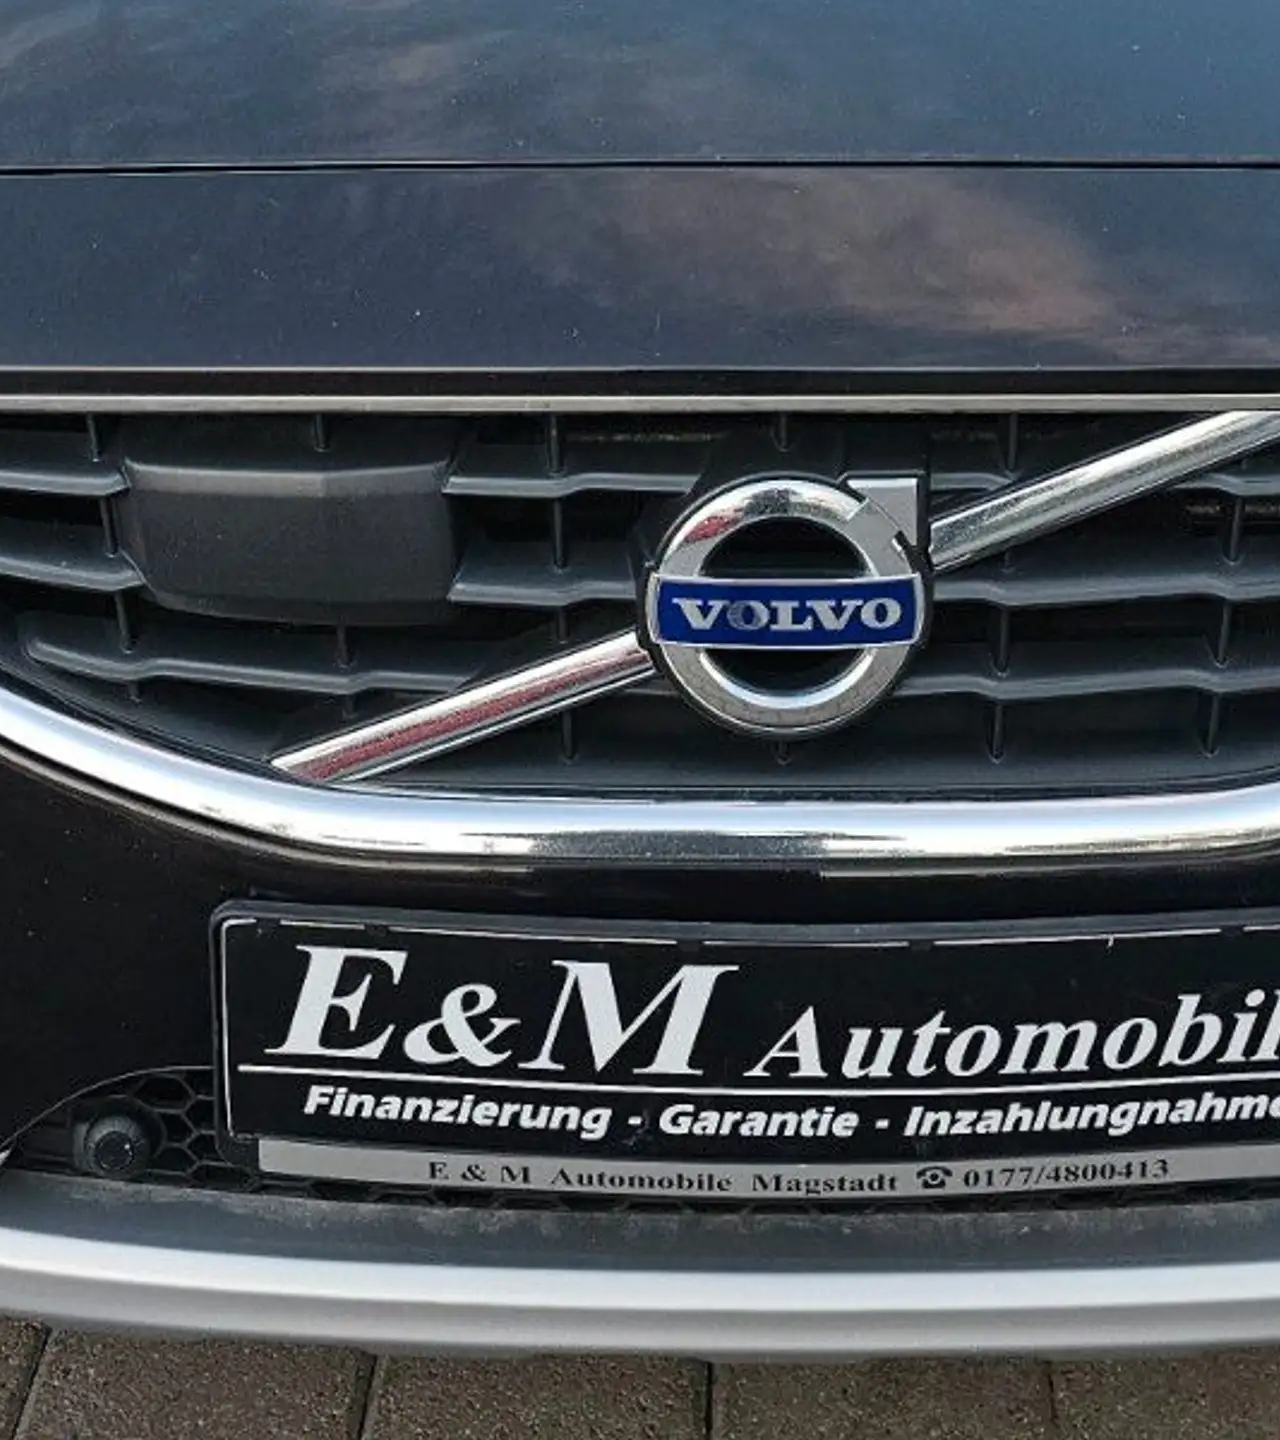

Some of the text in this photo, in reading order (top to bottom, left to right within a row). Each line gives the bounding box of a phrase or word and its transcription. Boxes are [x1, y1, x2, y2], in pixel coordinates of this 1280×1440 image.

[672, 597, 902, 632] VOLVO
[264, 945, 739, 1073] E&M
[303, 1084, 613, 1140] Finanzierung
[658, 1101, 859, 1138] Garantie
[428, 1158, 1170, 1195] E & M Automobile Magstadt 0177/4800413
